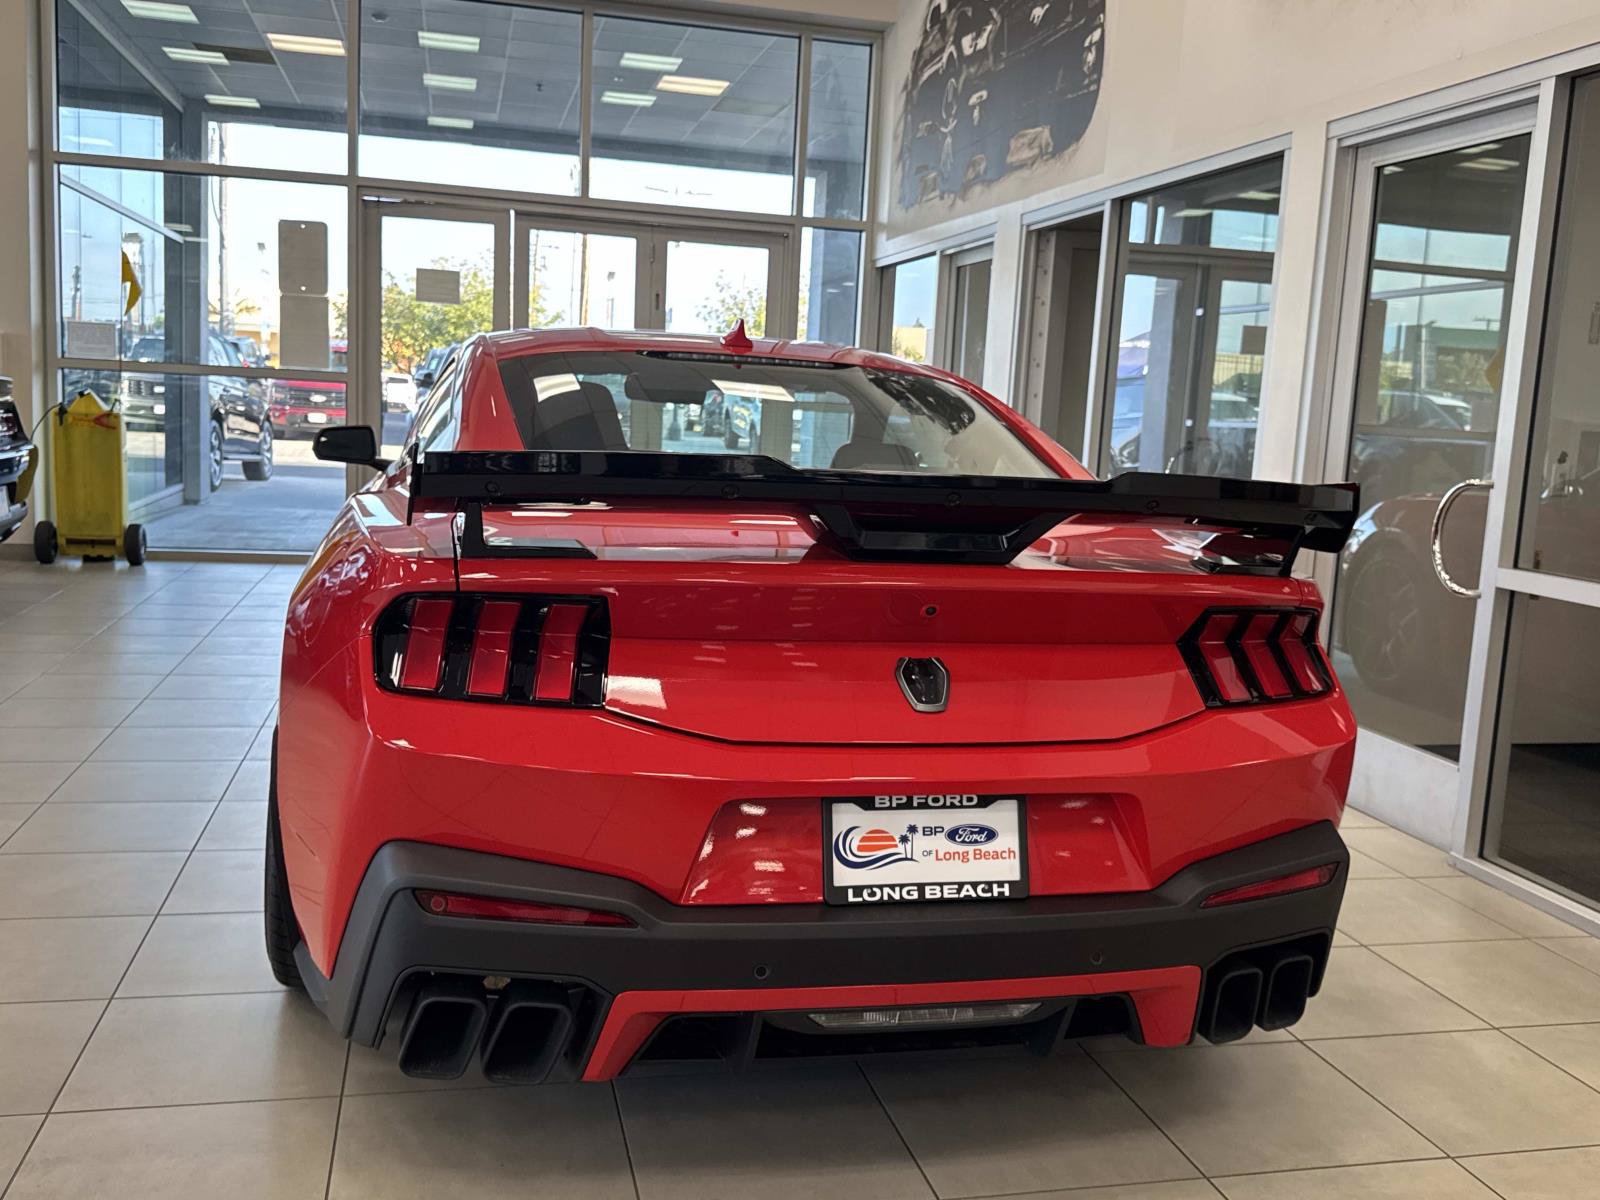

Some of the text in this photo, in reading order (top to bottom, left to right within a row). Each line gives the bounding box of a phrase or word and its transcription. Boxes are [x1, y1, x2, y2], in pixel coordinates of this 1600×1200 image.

[874, 794, 978, 808] BP FORD
[922, 826, 988, 842] BP Ford
[935, 849, 970, 863] Long
[973, 847, 1016, 860] Beach
[847, 883, 1010, 902] LONG BEACH
